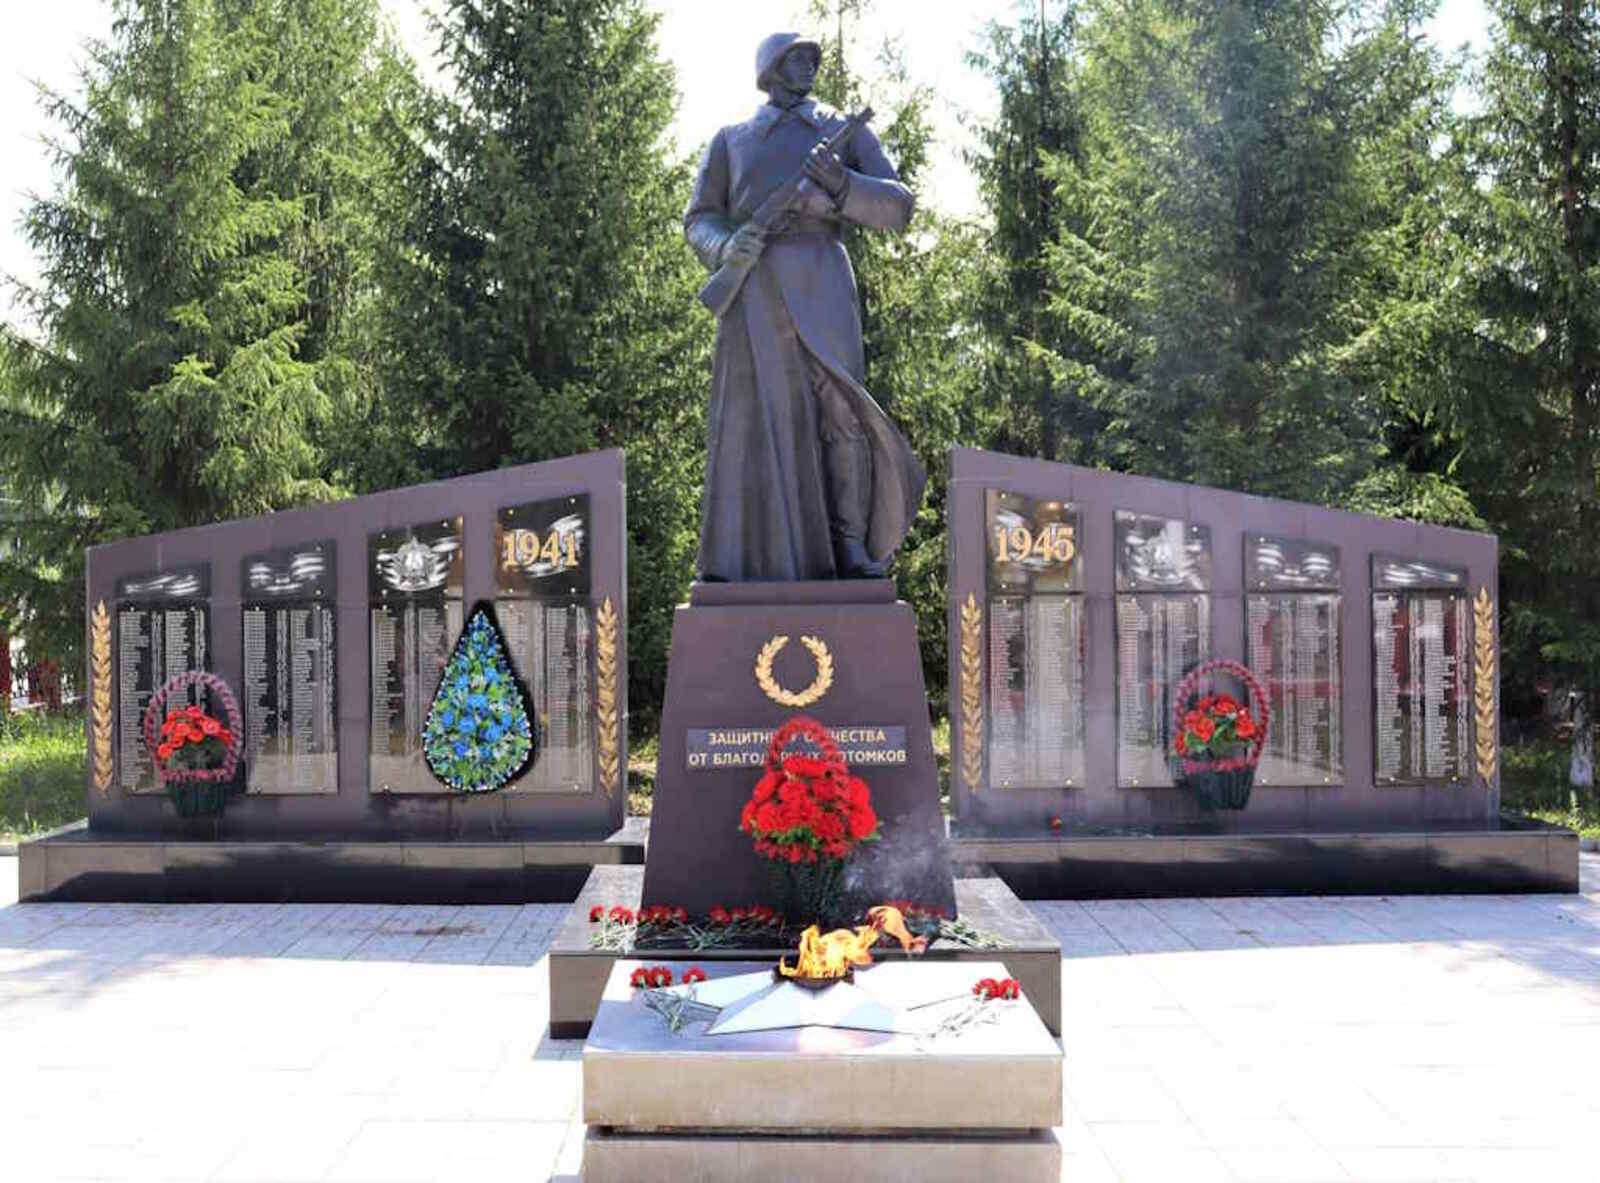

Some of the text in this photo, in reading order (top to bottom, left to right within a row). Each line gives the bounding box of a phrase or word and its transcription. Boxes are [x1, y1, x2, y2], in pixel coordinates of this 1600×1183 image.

[503, 529, 579, 568] 1941
[996, 526, 1075, 562] 1945
[688, 753, 707, 766] ОТ
